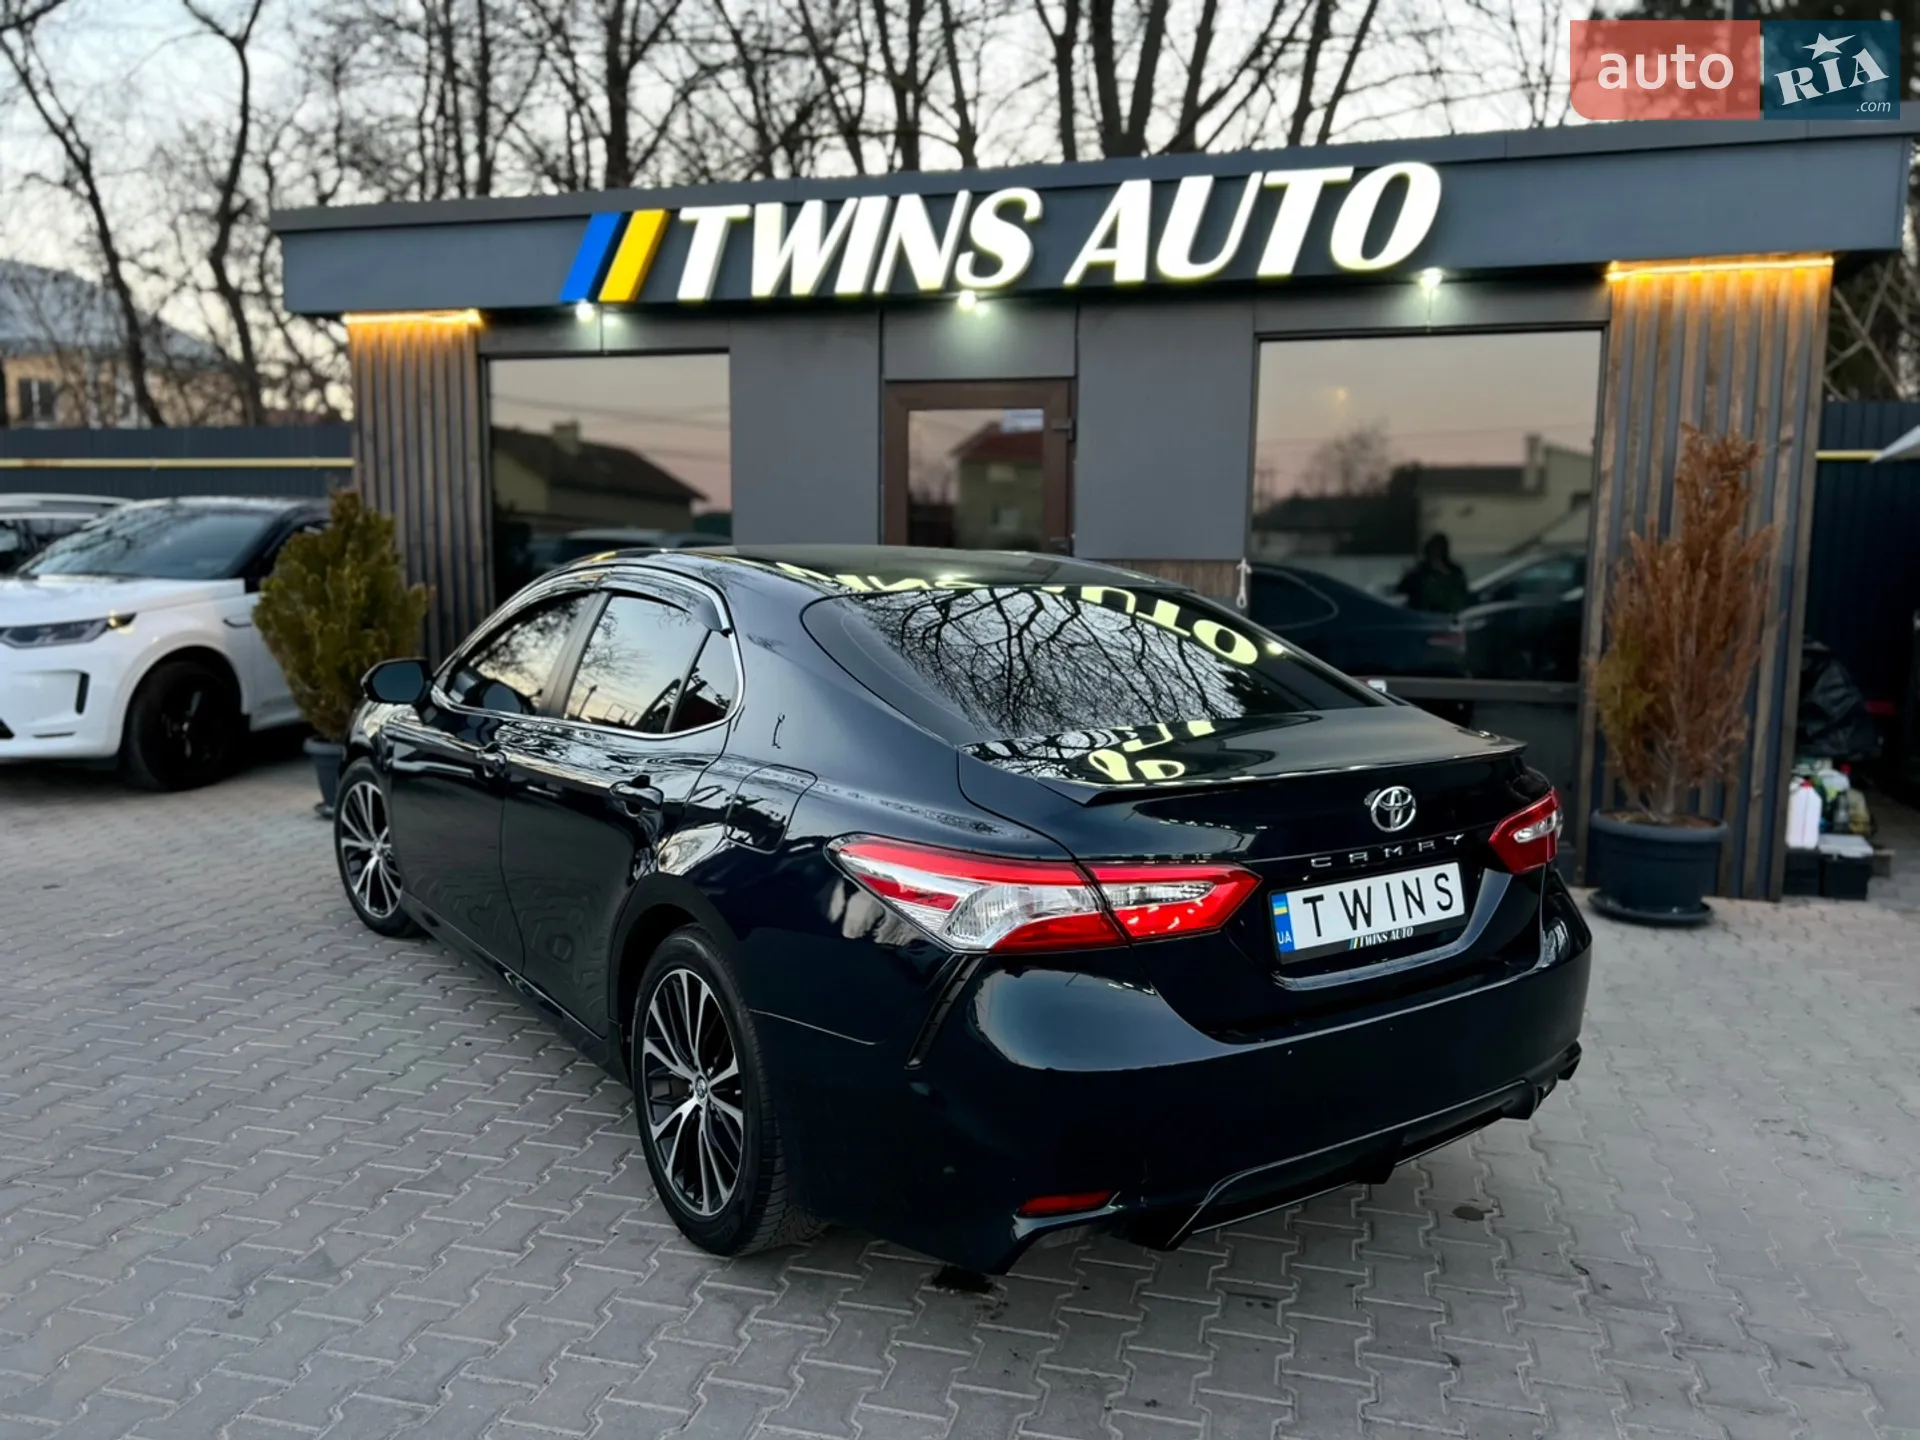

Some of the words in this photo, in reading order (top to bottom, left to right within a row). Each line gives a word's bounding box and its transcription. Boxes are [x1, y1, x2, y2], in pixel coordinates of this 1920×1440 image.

[677, 186, 1043, 300] TWINS
[1063, 161, 1443, 287] AUTO
[1311, 833, 1464, 868] CAMRY
[1303, 873, 1453, 937] TWINS
[1276, 930, 1292, 944] UA
[1360, 932, 1388, 948] TWINS
[1389, 926, 1414, 941] AUTO
